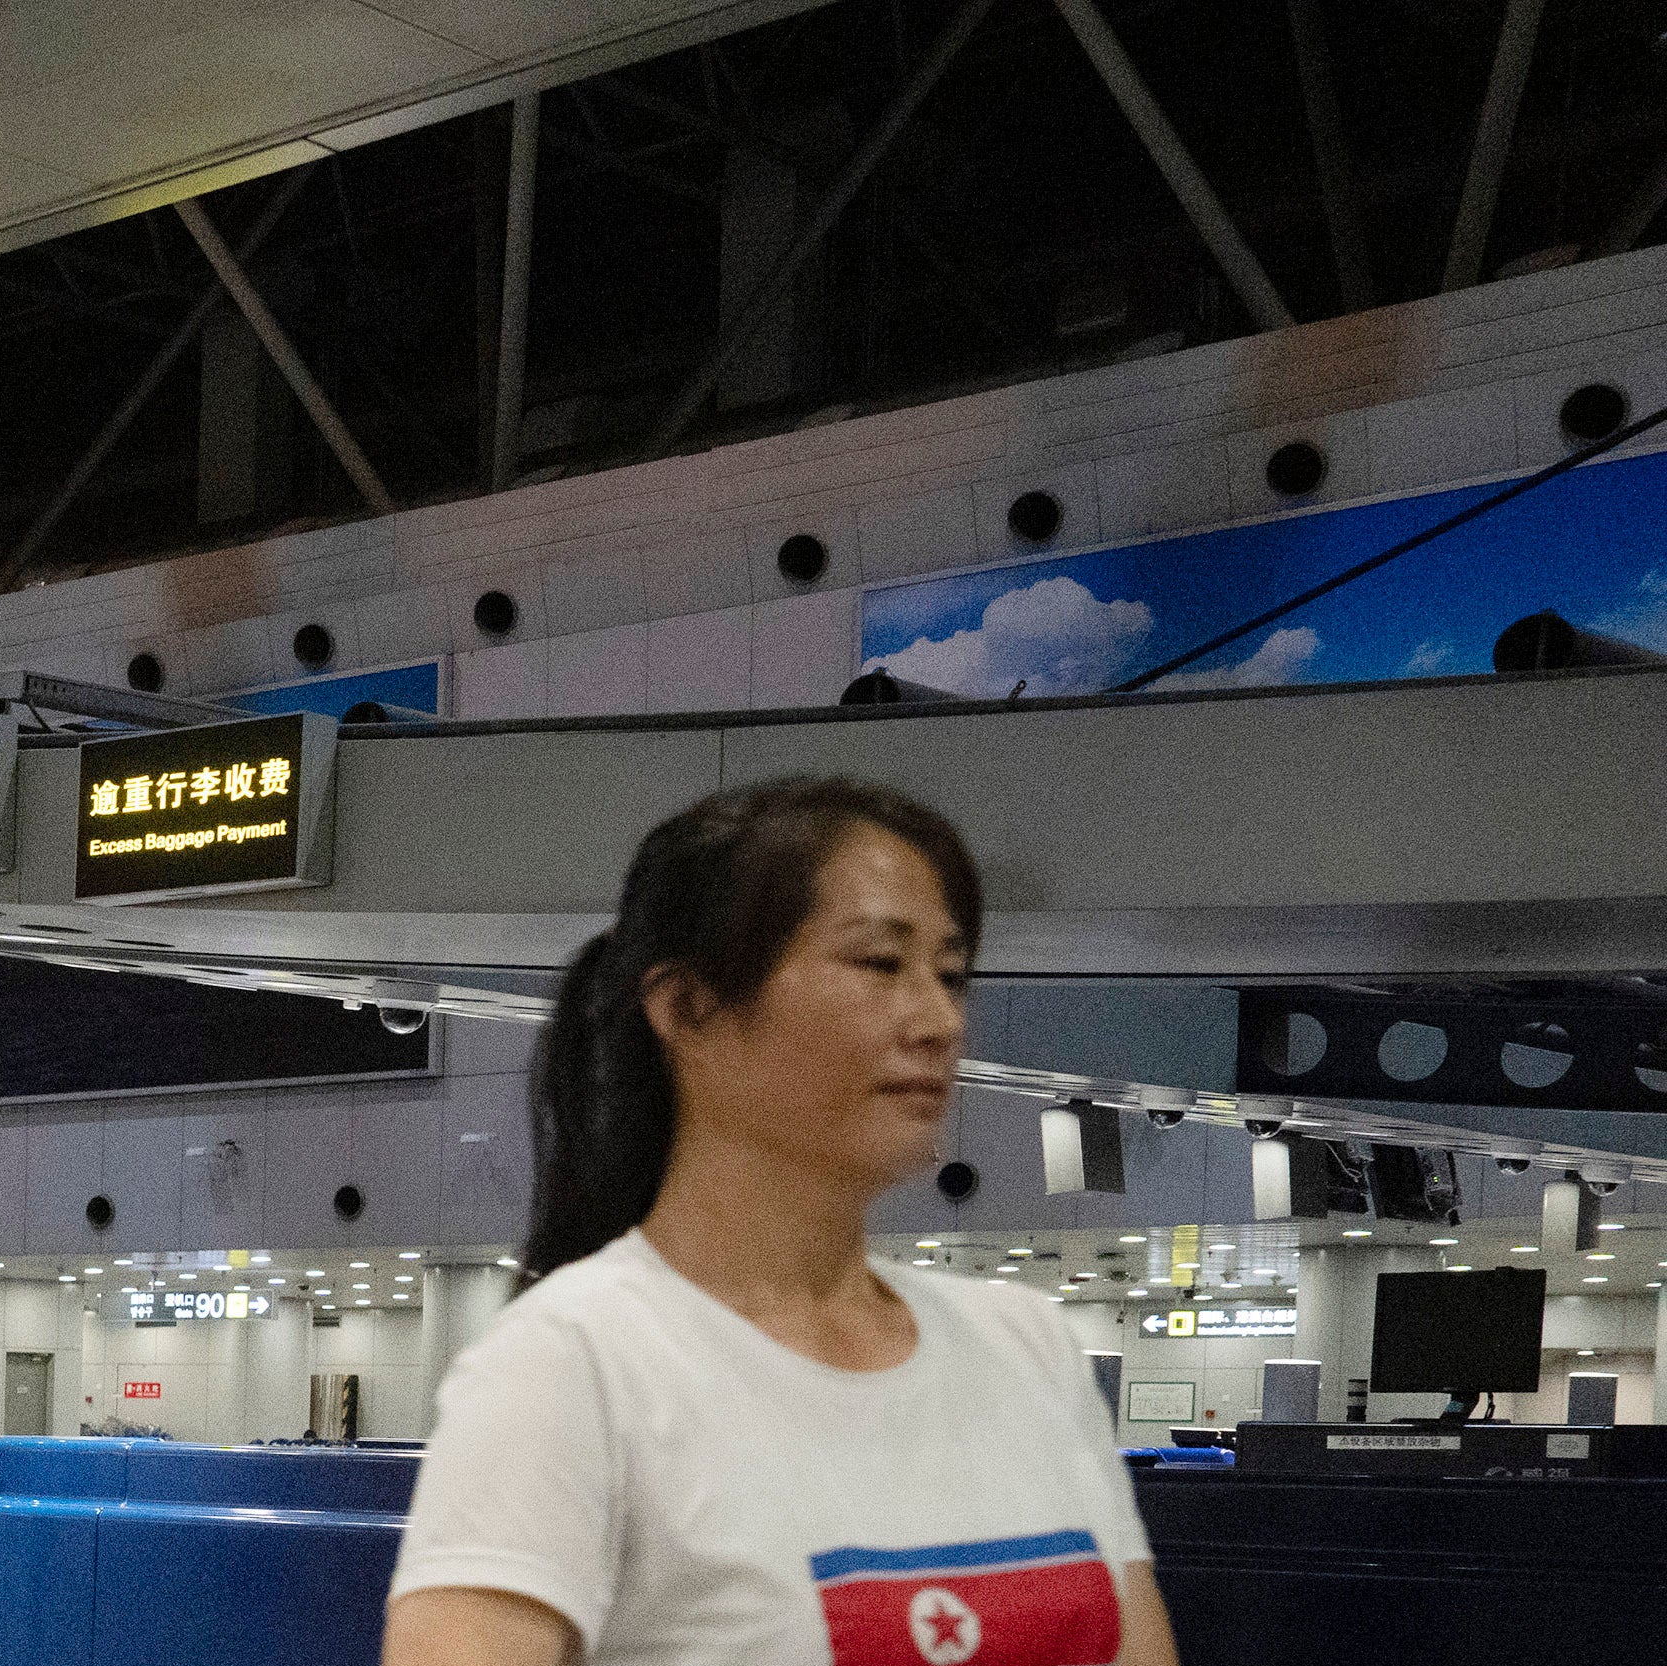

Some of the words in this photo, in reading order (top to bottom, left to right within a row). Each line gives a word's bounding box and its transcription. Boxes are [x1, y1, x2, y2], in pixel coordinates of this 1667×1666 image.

[89, 757, 292, 817] 逾重行李收费
[89, 836, 143, 857] Excess
[144, 829, 216, 852] Baggage
[216, 819, 287, 844] Payment
[195, 1293, 225, 1319] 90
